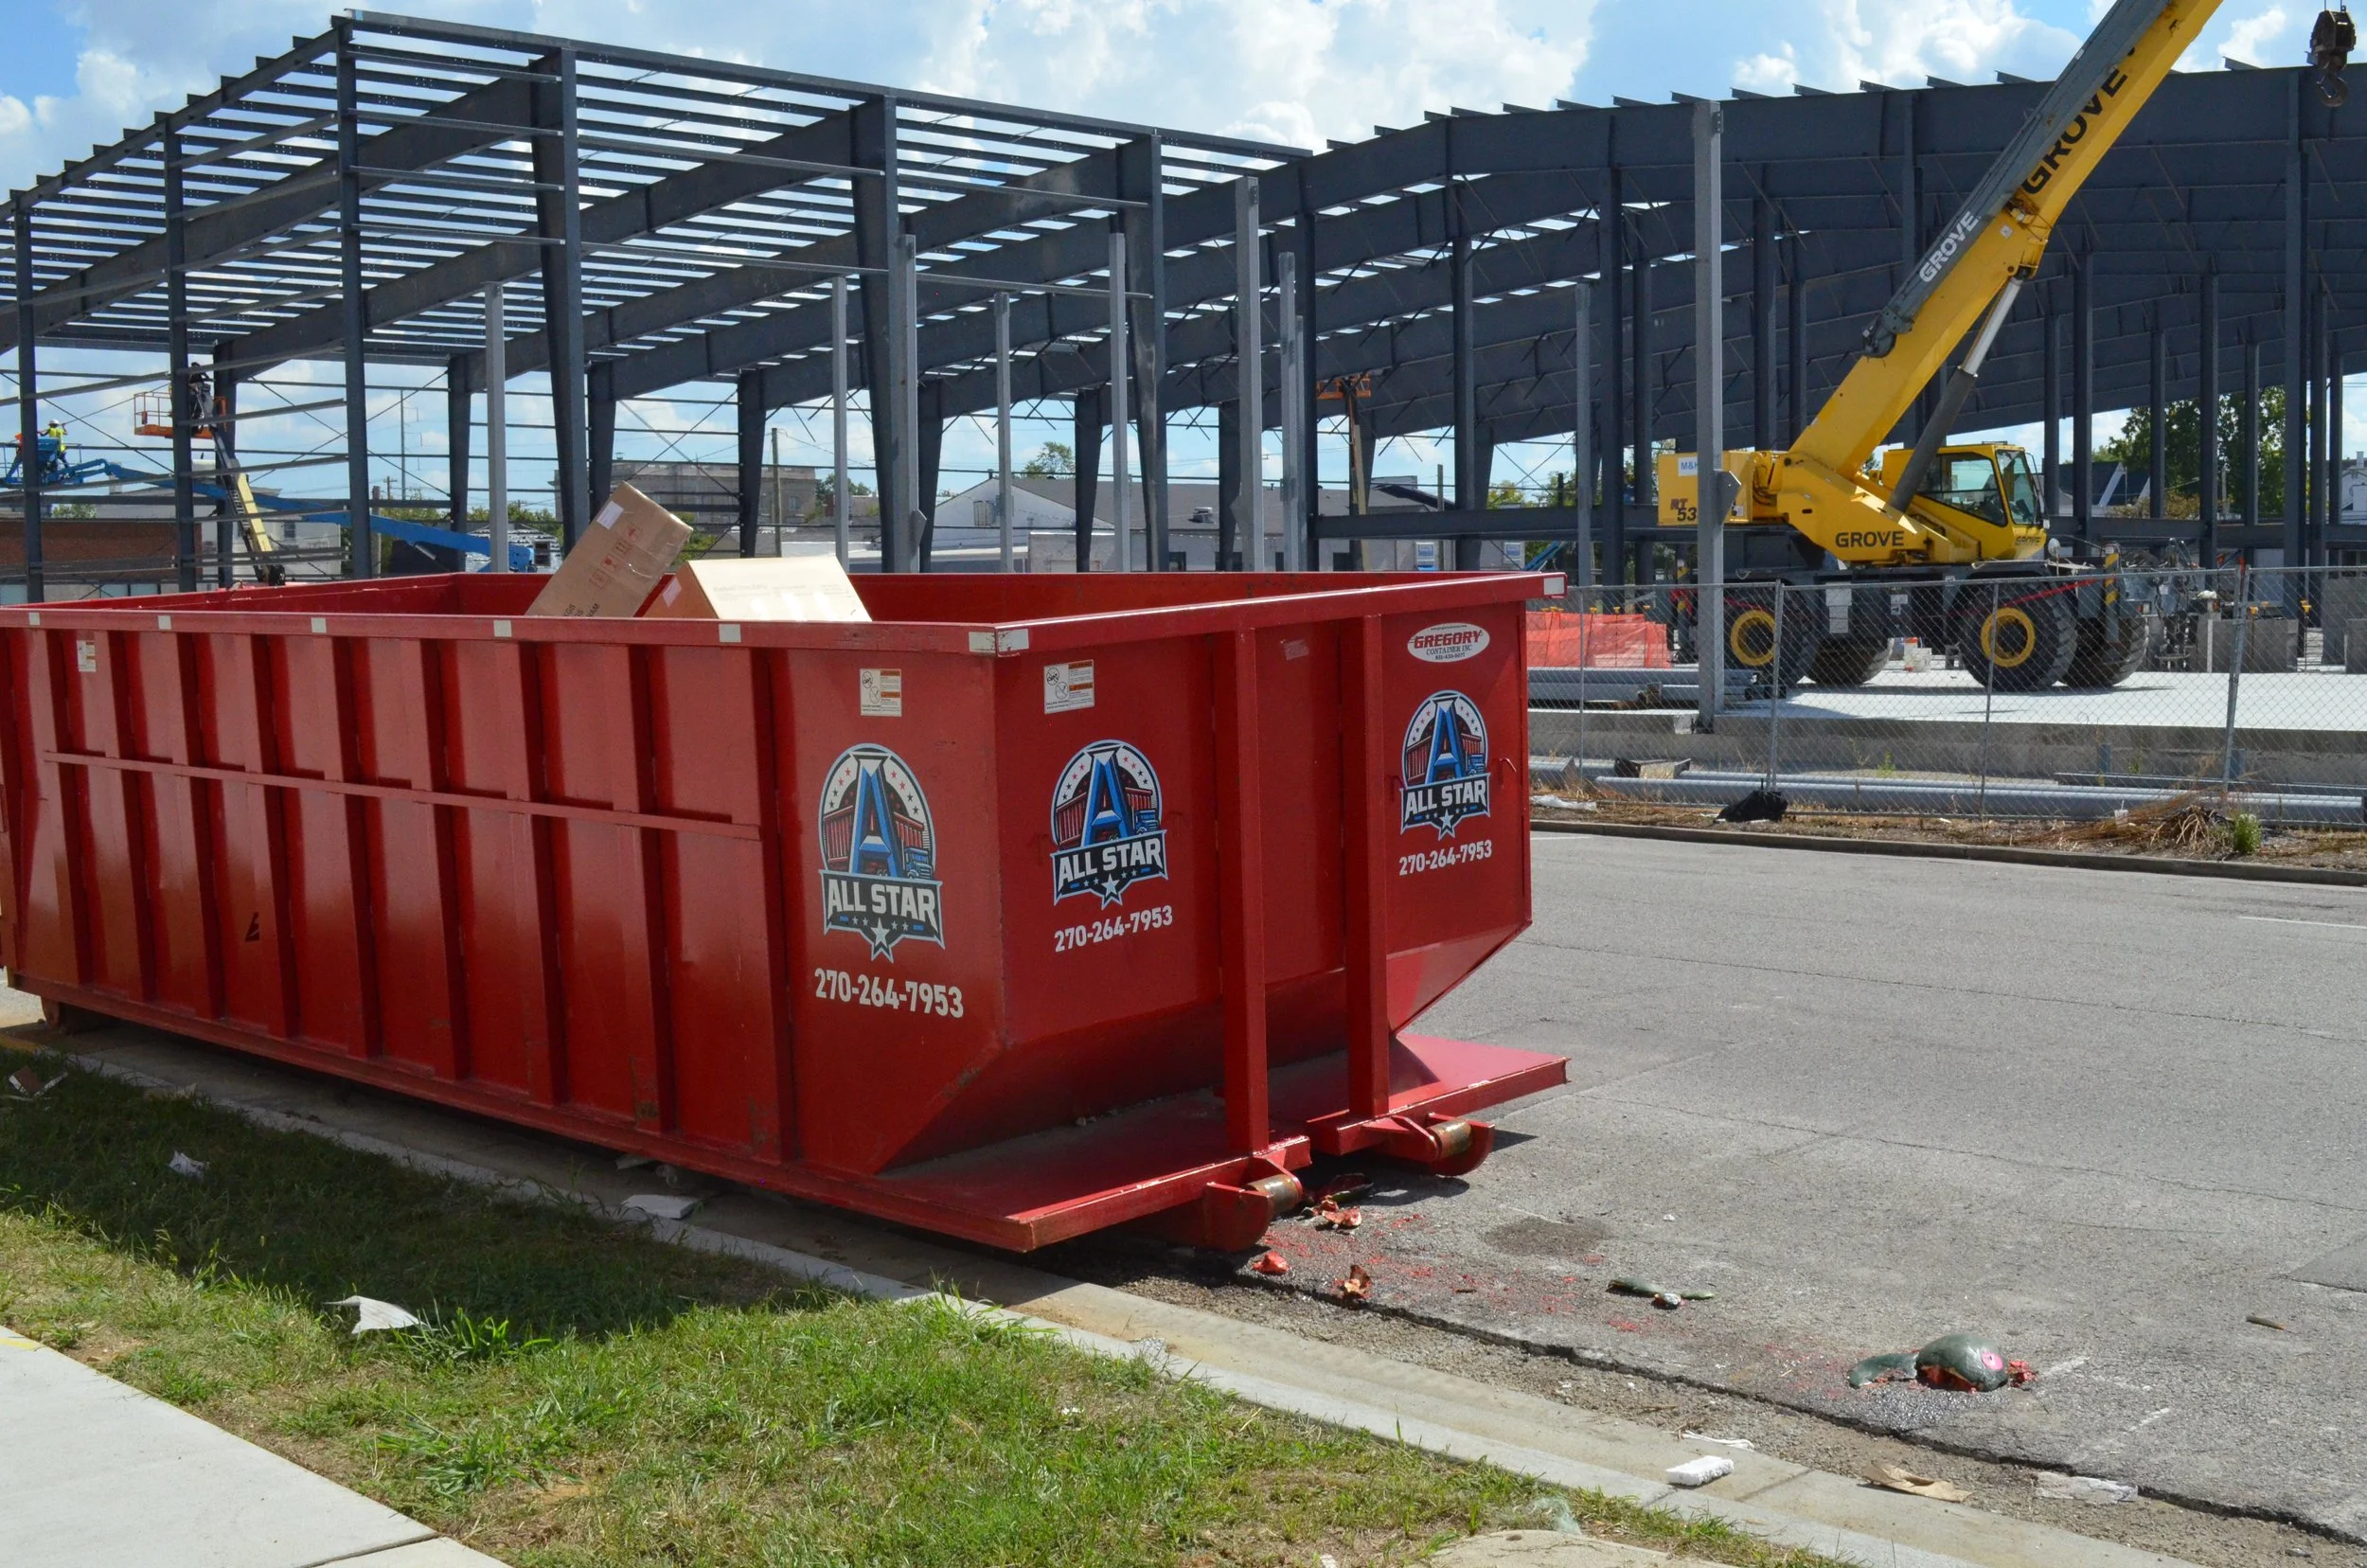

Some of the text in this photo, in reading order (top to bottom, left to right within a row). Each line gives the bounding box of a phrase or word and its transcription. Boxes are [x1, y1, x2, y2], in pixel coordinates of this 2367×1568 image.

[2021, 68, 2128, 195] GROVE
[1919, 211, 1979, 282] GROVE
[1835, 531, 1904, 548] GROVE
[1414, 631, 1481, 649] GREGORY
[1426, 644, 1461, 655] CONTAINER
[1405, 779, 1486, 821] ALL STAR
[1058, 837, 1164, 895] ALL STAR
[1398, 840, 1492, 876] 270-264-7953
[827, 879, 939, 933] ALL STAR
[1054, 905, 1173, 953] 270-264-7953
[814, 968, 964, 1019] 270-264-7953
